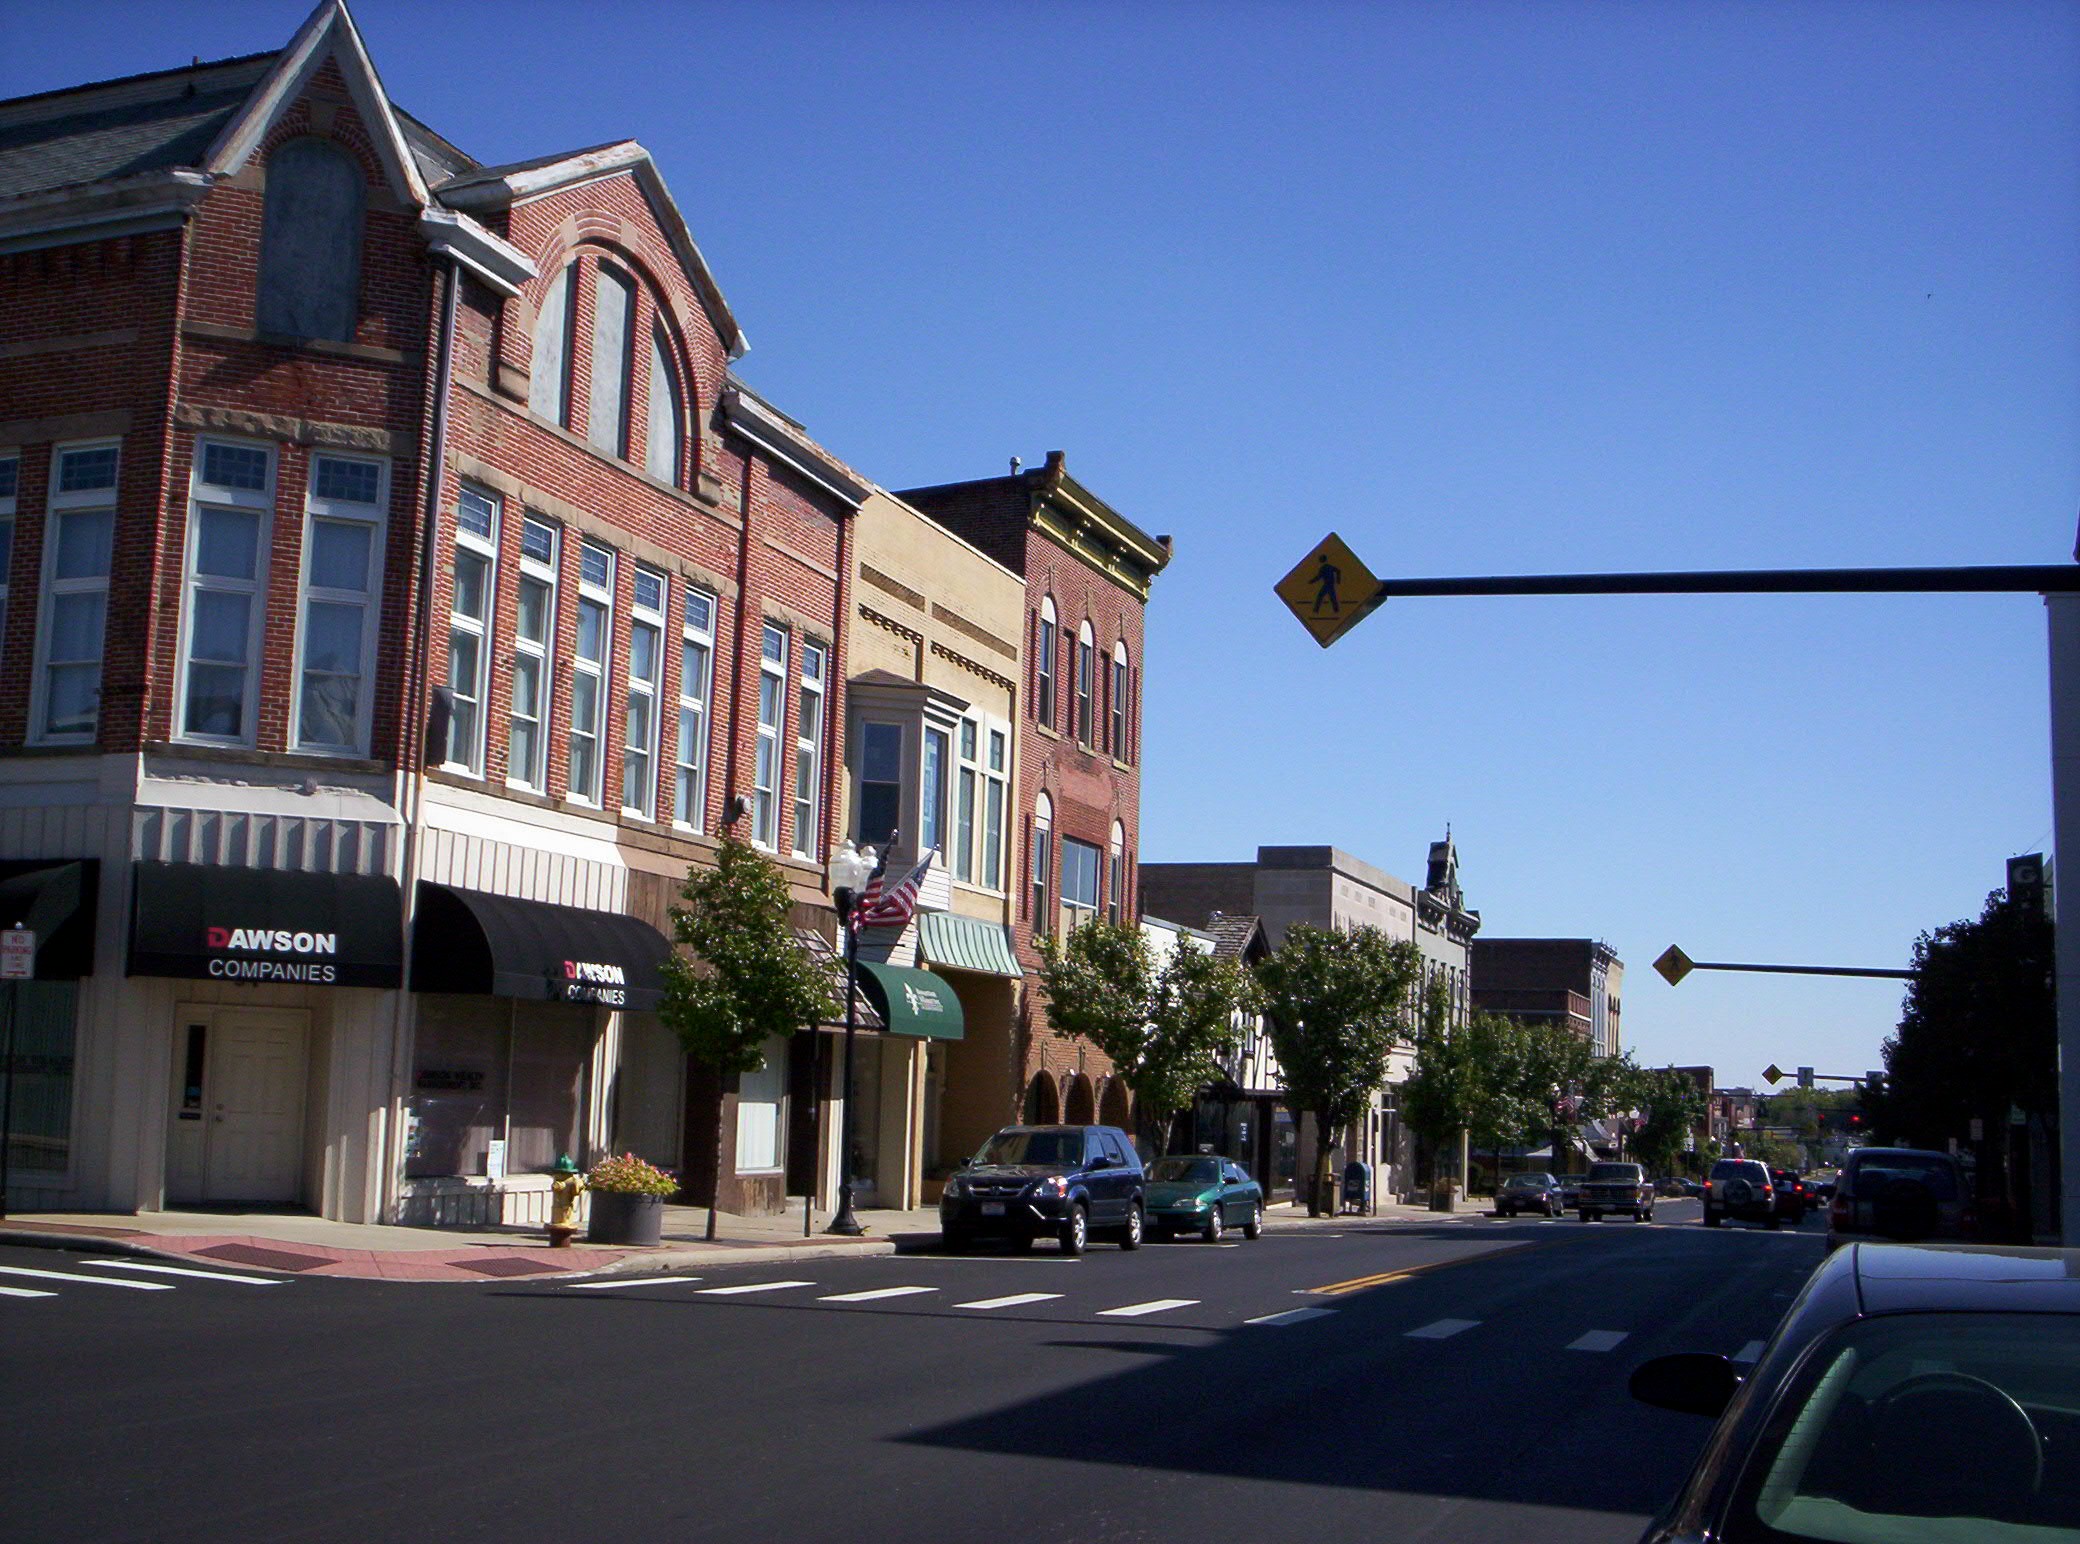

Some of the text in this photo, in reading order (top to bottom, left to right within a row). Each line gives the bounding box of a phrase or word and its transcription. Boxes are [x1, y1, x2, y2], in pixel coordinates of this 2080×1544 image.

[11, 935, 25, 945] NO
[208, 927, 336, 953] DAWSON
[209, 959, 335, 982] COMPANIES
[563, 960, 625, 985] DAWSON
